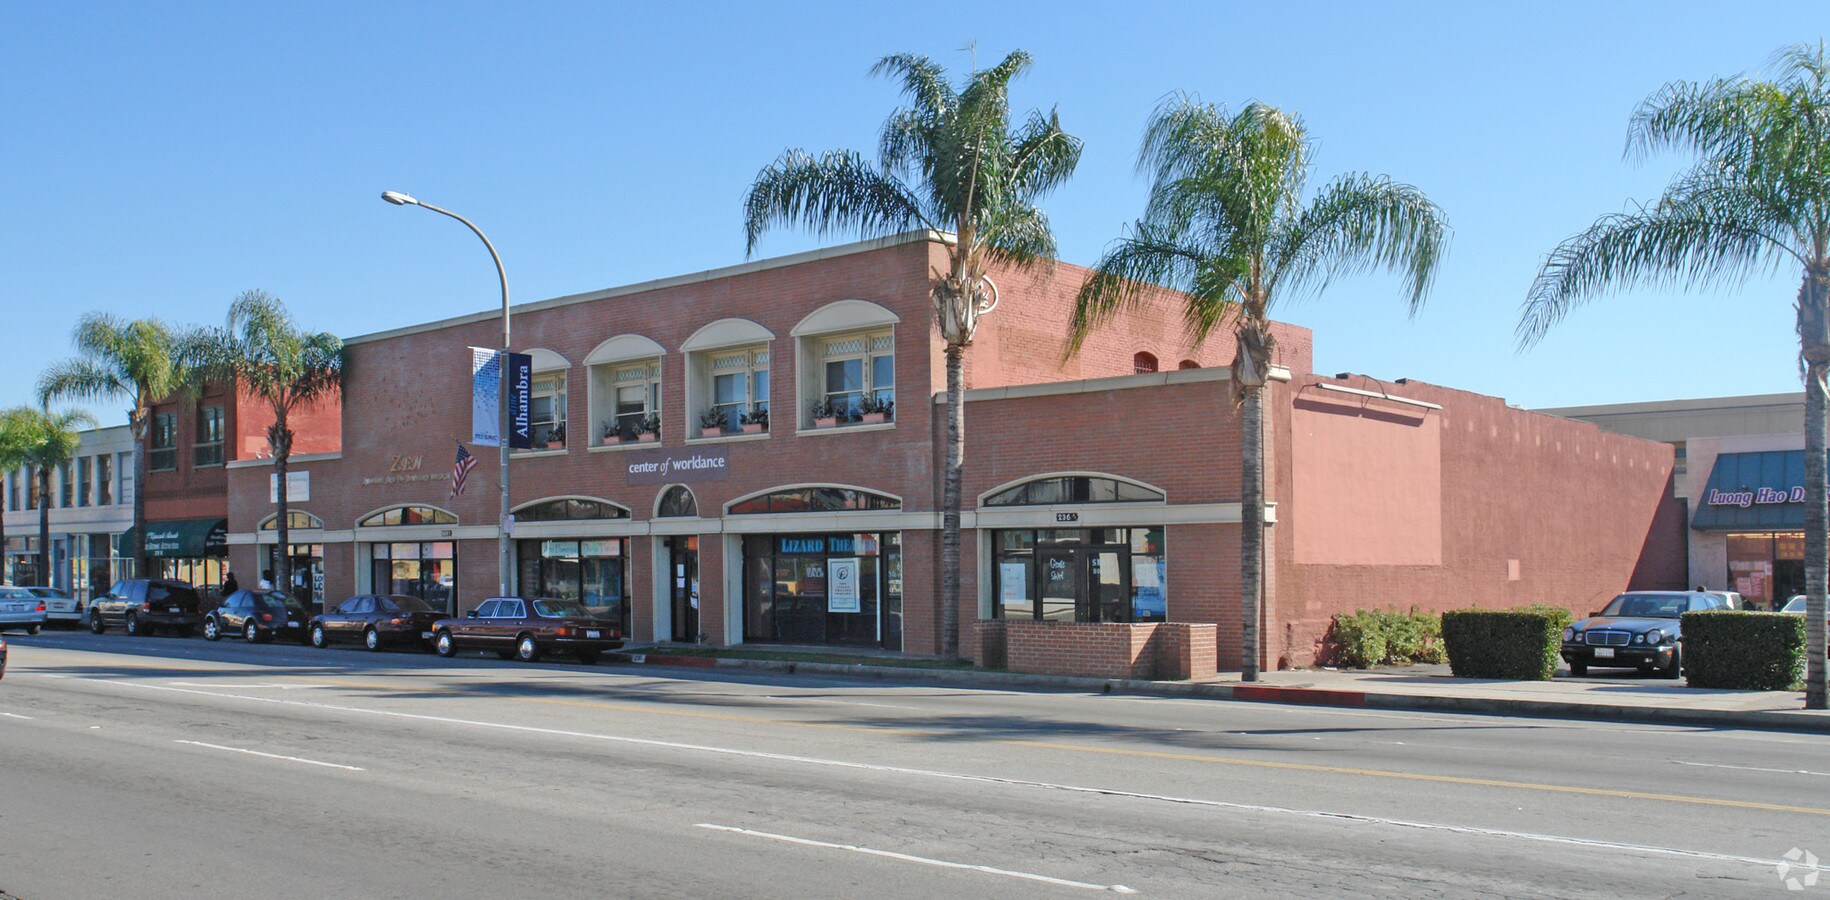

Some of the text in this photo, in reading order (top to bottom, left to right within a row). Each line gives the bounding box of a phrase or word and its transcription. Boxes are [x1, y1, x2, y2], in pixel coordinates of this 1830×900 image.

[516, 365, 528, 438] Alhambra
[629, 455, 725, 476] center of worldance
[1708, 486, 1806, 508] Luong Hao D
[781, 537, 823, 553] LIZARD
